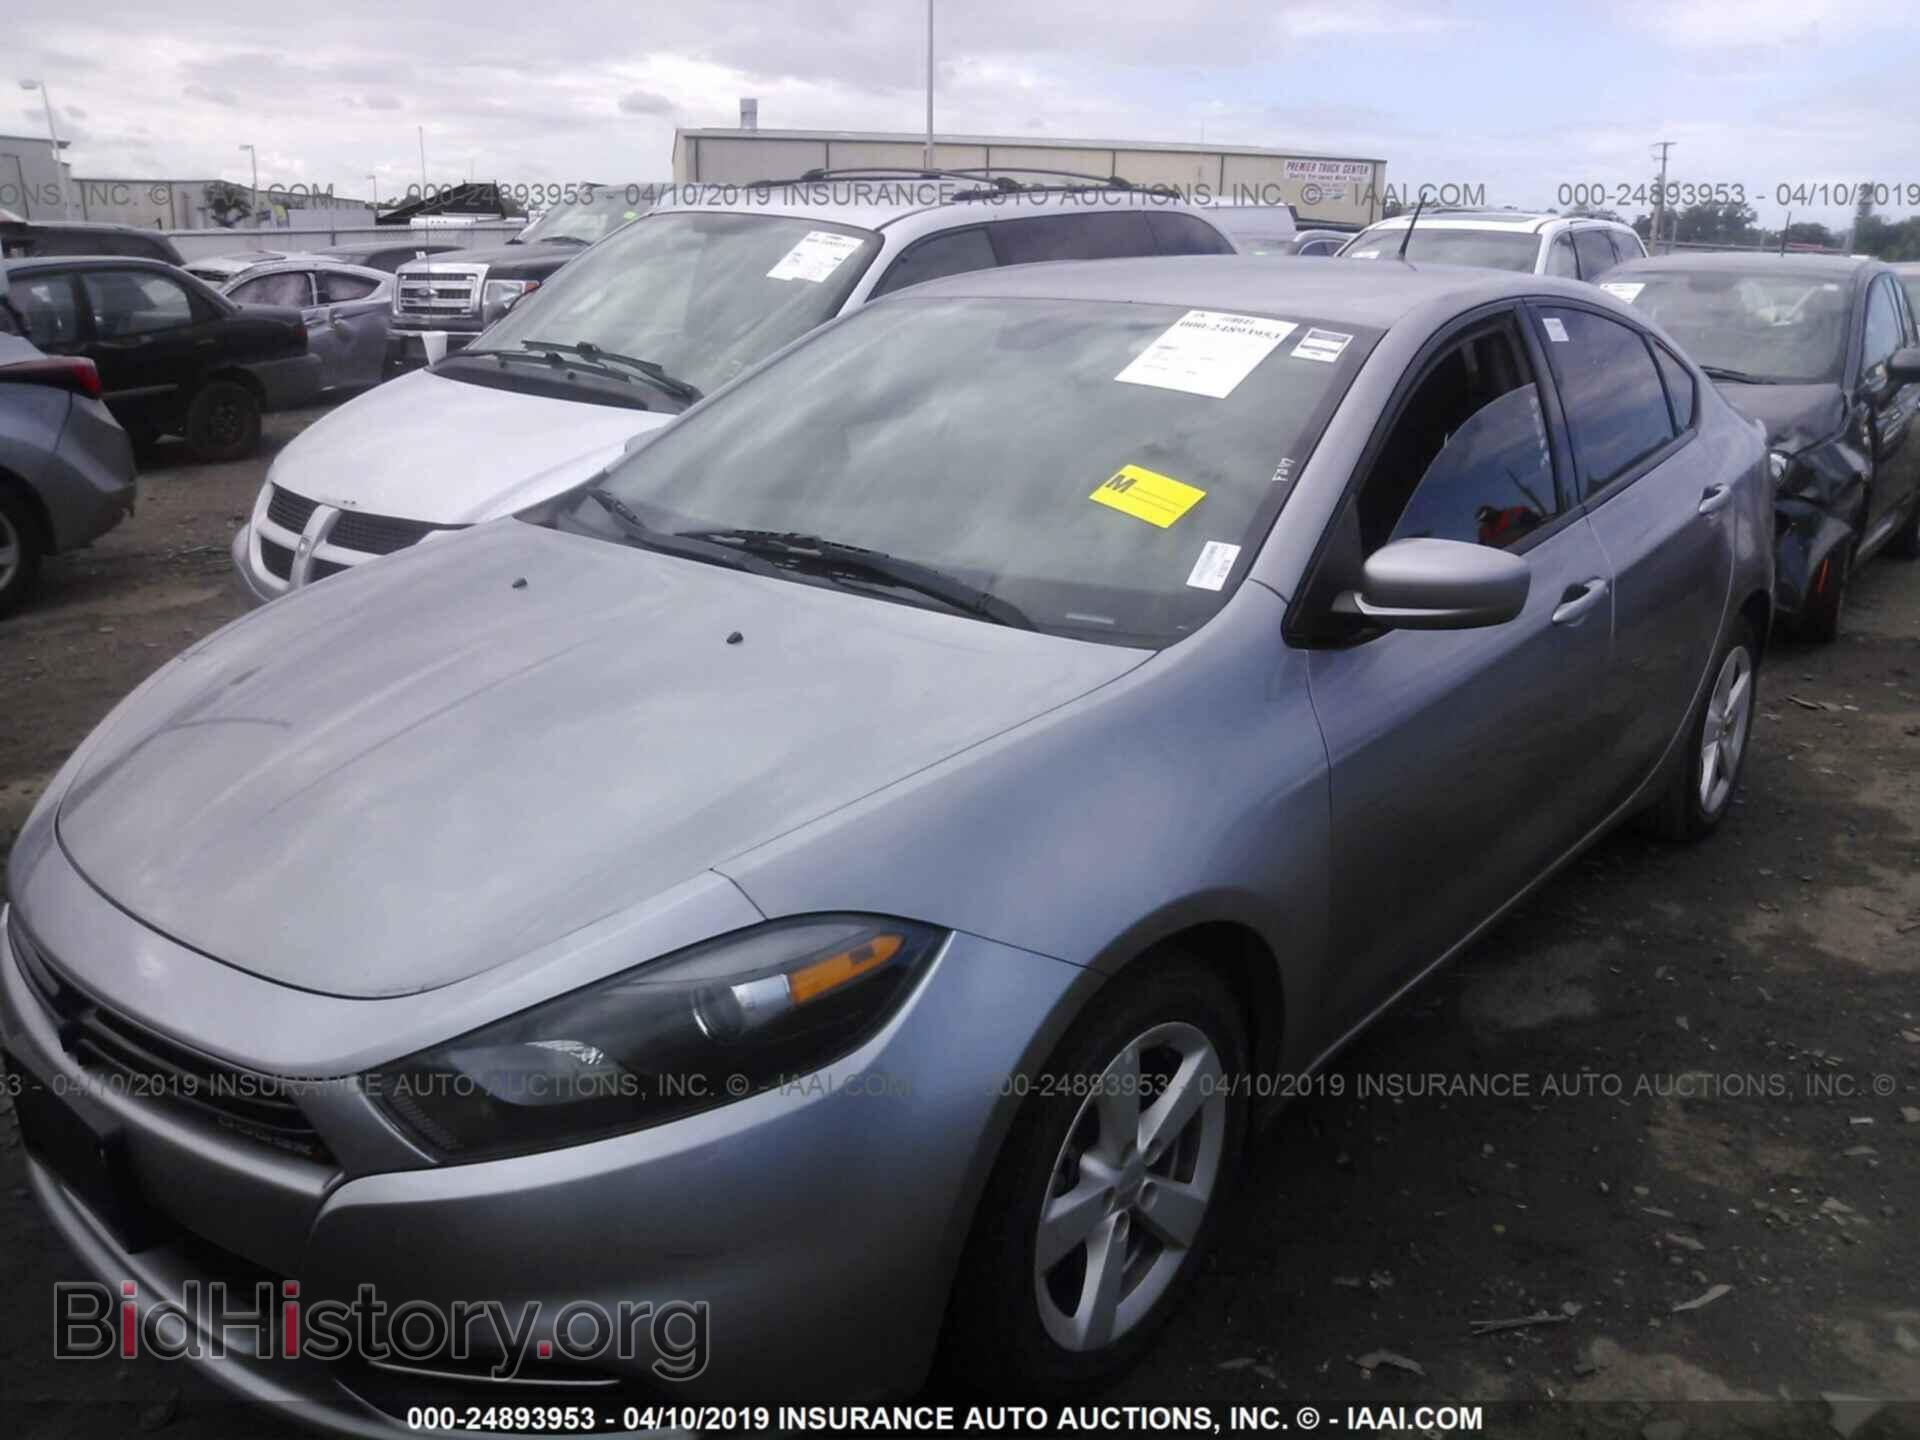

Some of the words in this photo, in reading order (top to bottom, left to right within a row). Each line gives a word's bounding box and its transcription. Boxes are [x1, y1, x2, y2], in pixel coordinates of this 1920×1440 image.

[1286, 161, 1317, 173] PREMIER
[1319, 163, 1340, 174] TRUCK
[1342, 164, 1369, 175] CENTER
[1104, 474, 1138, 494] M
